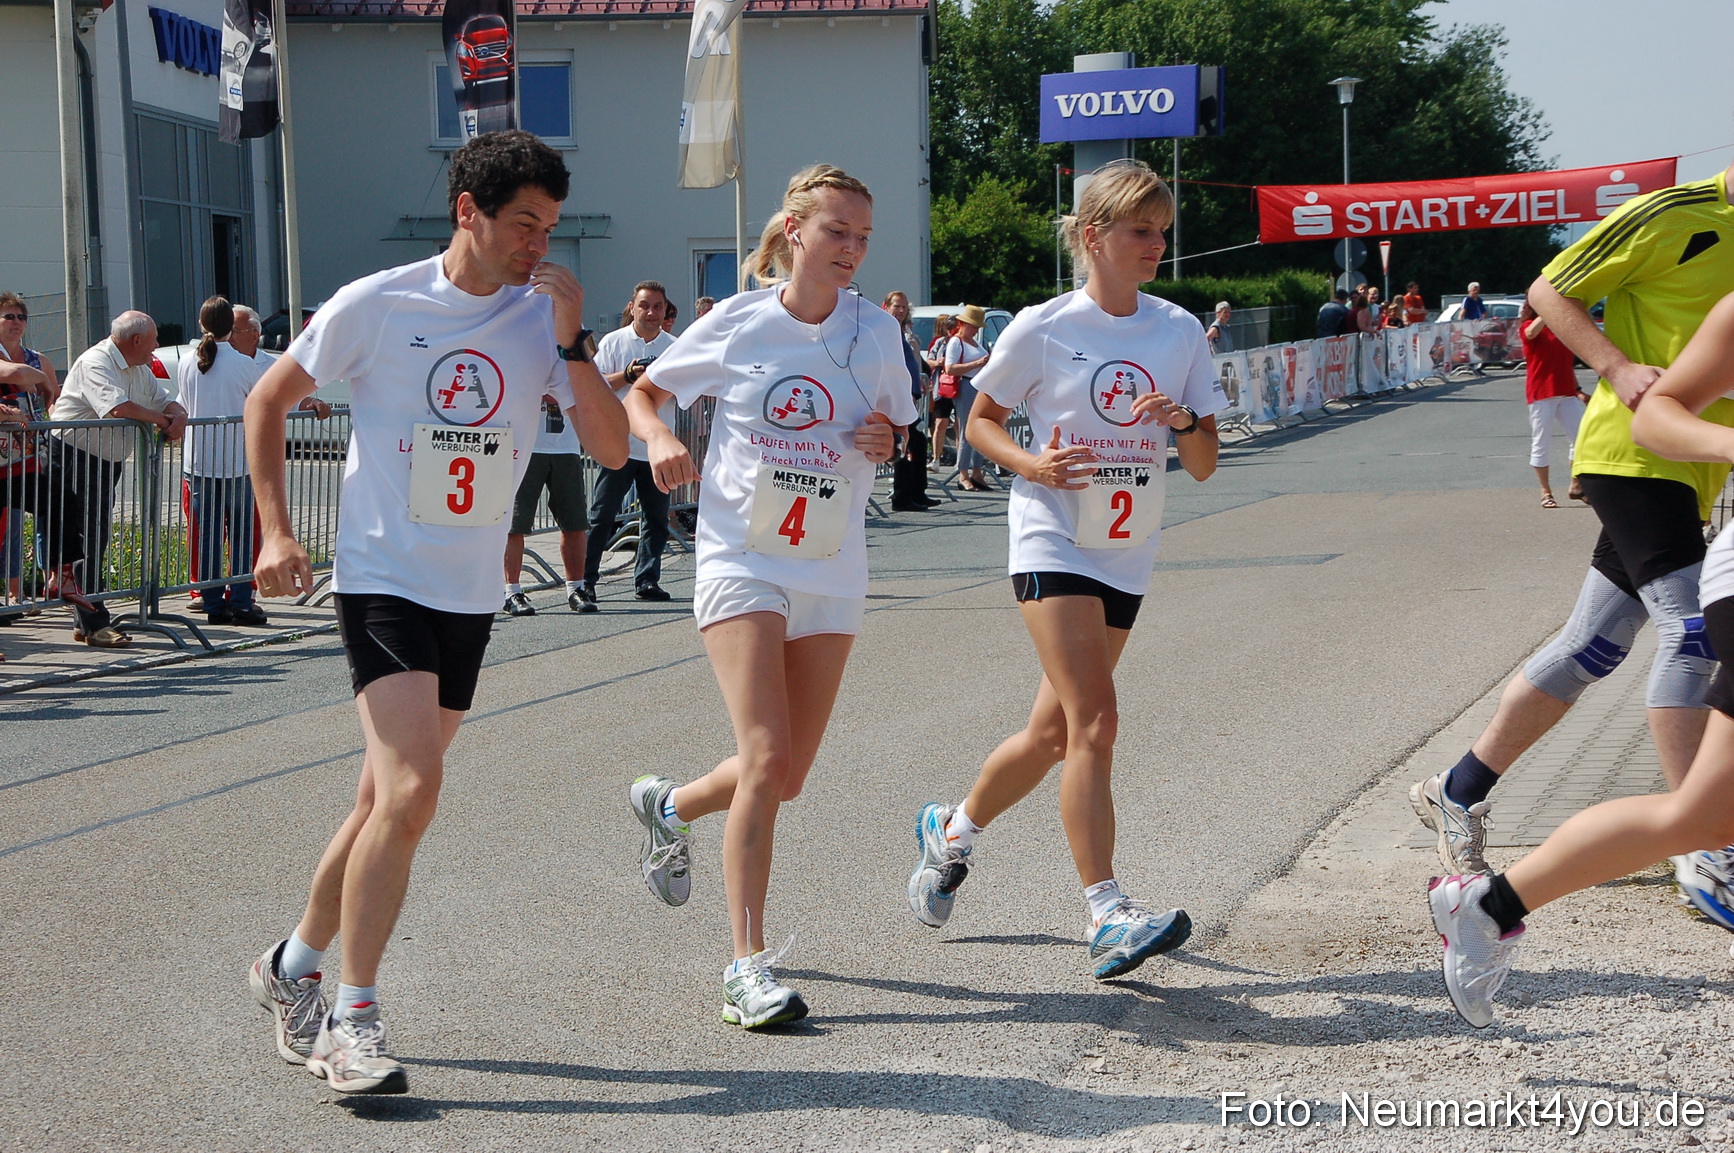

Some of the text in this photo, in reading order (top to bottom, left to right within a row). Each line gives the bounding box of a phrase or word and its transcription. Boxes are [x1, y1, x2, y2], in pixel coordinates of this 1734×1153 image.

[1054, 88, 1175, 118] VOLVO
[1346, 189, 1581, 234] START+ZIEL
[432, 430, 481, 444] MEYER
[1071, 433, 1114, 448] LAUFEN
[431, 442, 482, 453] WERBUNG
[795, 442, 816, 452] MIT
[773, 470, 818, 487] MEYER
[1092, 467, 1132, 477] MEYER
[447, 457, 475, 514] 3
[772, 481, 817, 495] WERBUNG
[1092, 477, 1133, 486] WERBUNG
[778, 496, 808, 546] 4
[1108, 490, 1133, 539] 2
